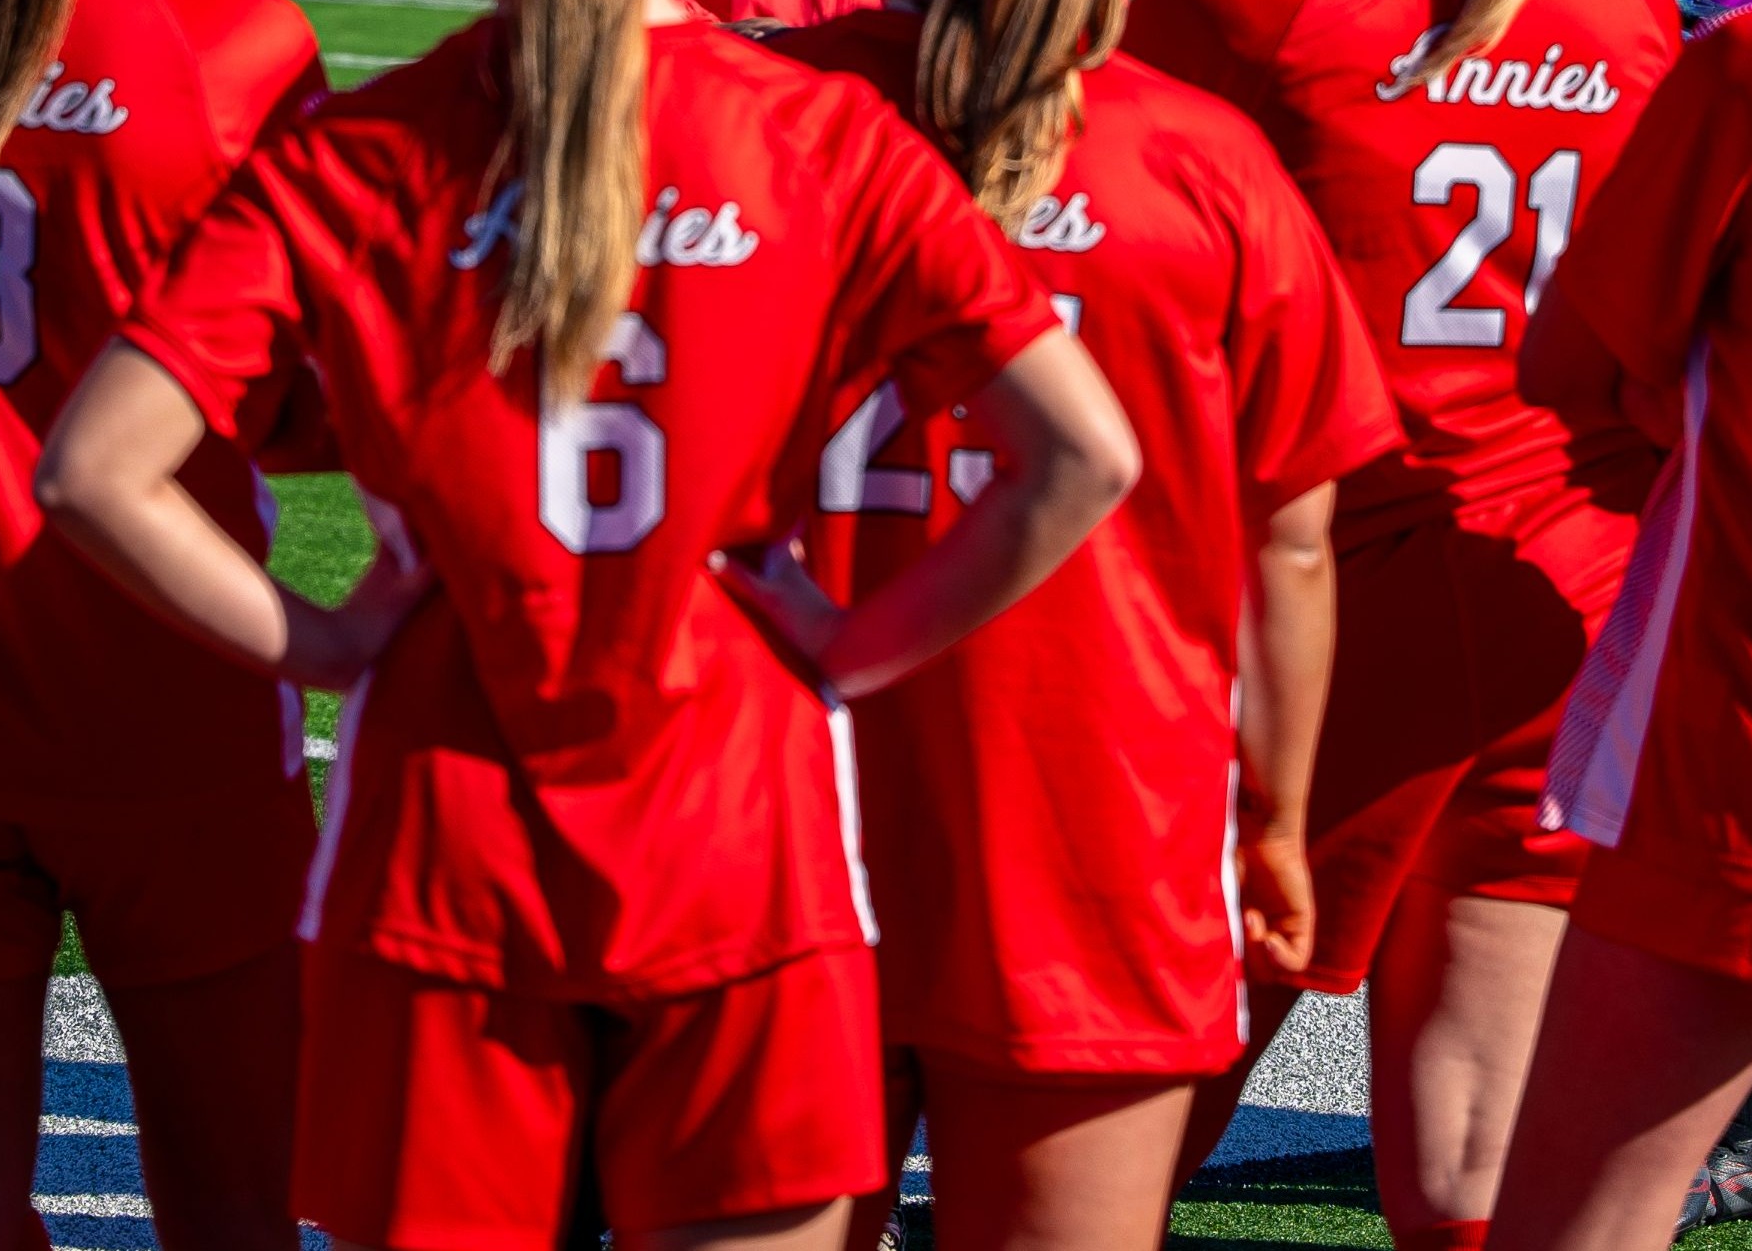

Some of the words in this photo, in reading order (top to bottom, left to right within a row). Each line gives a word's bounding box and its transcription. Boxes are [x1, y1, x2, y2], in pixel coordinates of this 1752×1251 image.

[1375, 22, 1619, 114] Annies
[450, 180, 761, 270] Aies
[1401, 142, 1582, 347] 21
[537, 309, 668, 555] 6
[818, 291, 1083, 515] 2
